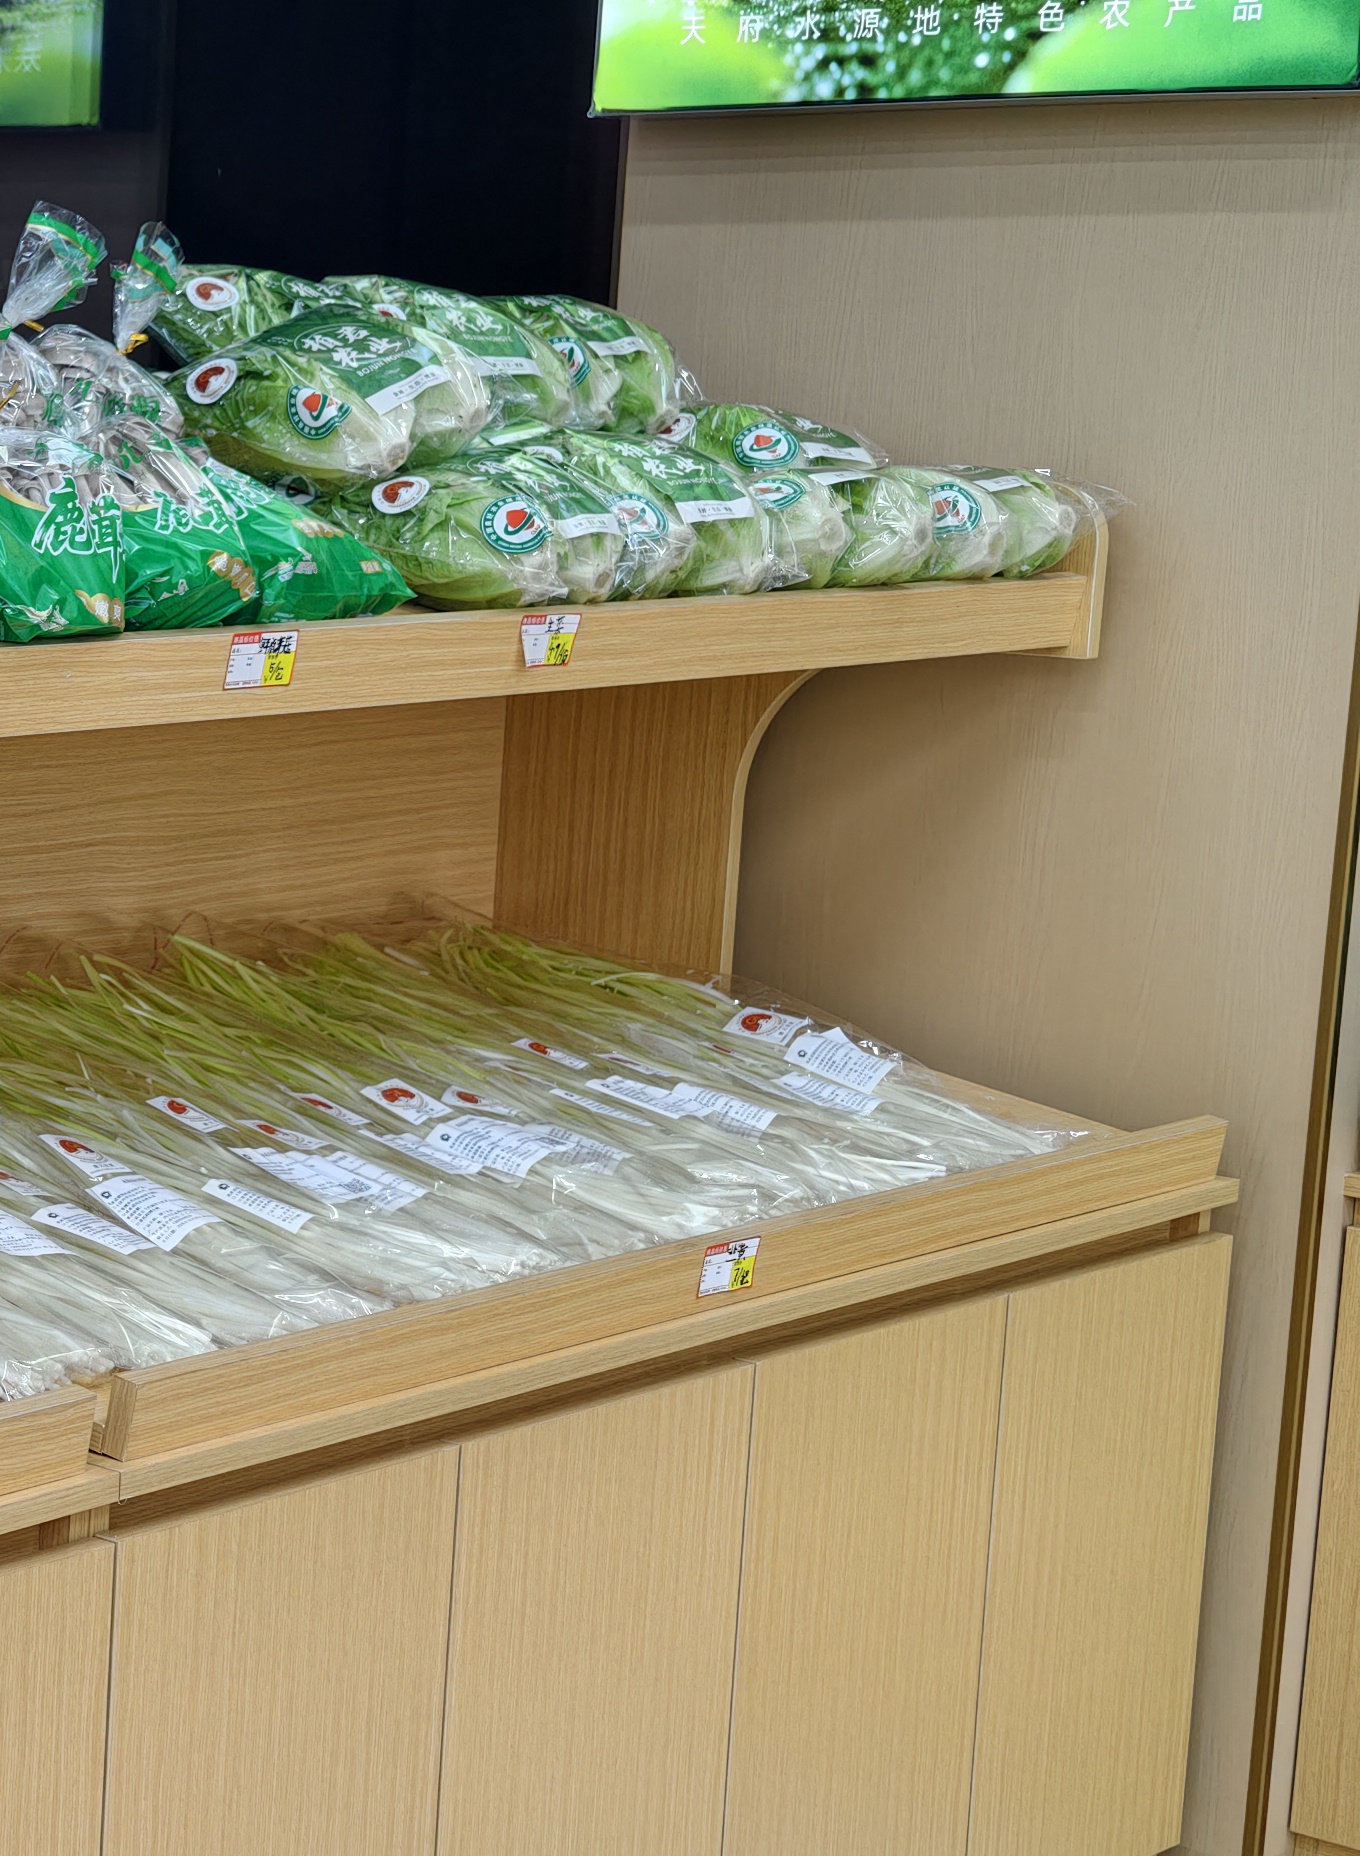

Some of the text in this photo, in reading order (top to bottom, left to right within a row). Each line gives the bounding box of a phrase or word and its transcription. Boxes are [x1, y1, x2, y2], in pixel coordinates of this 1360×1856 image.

[680, 0, 1264, 45] 天府水源地特色农产品
